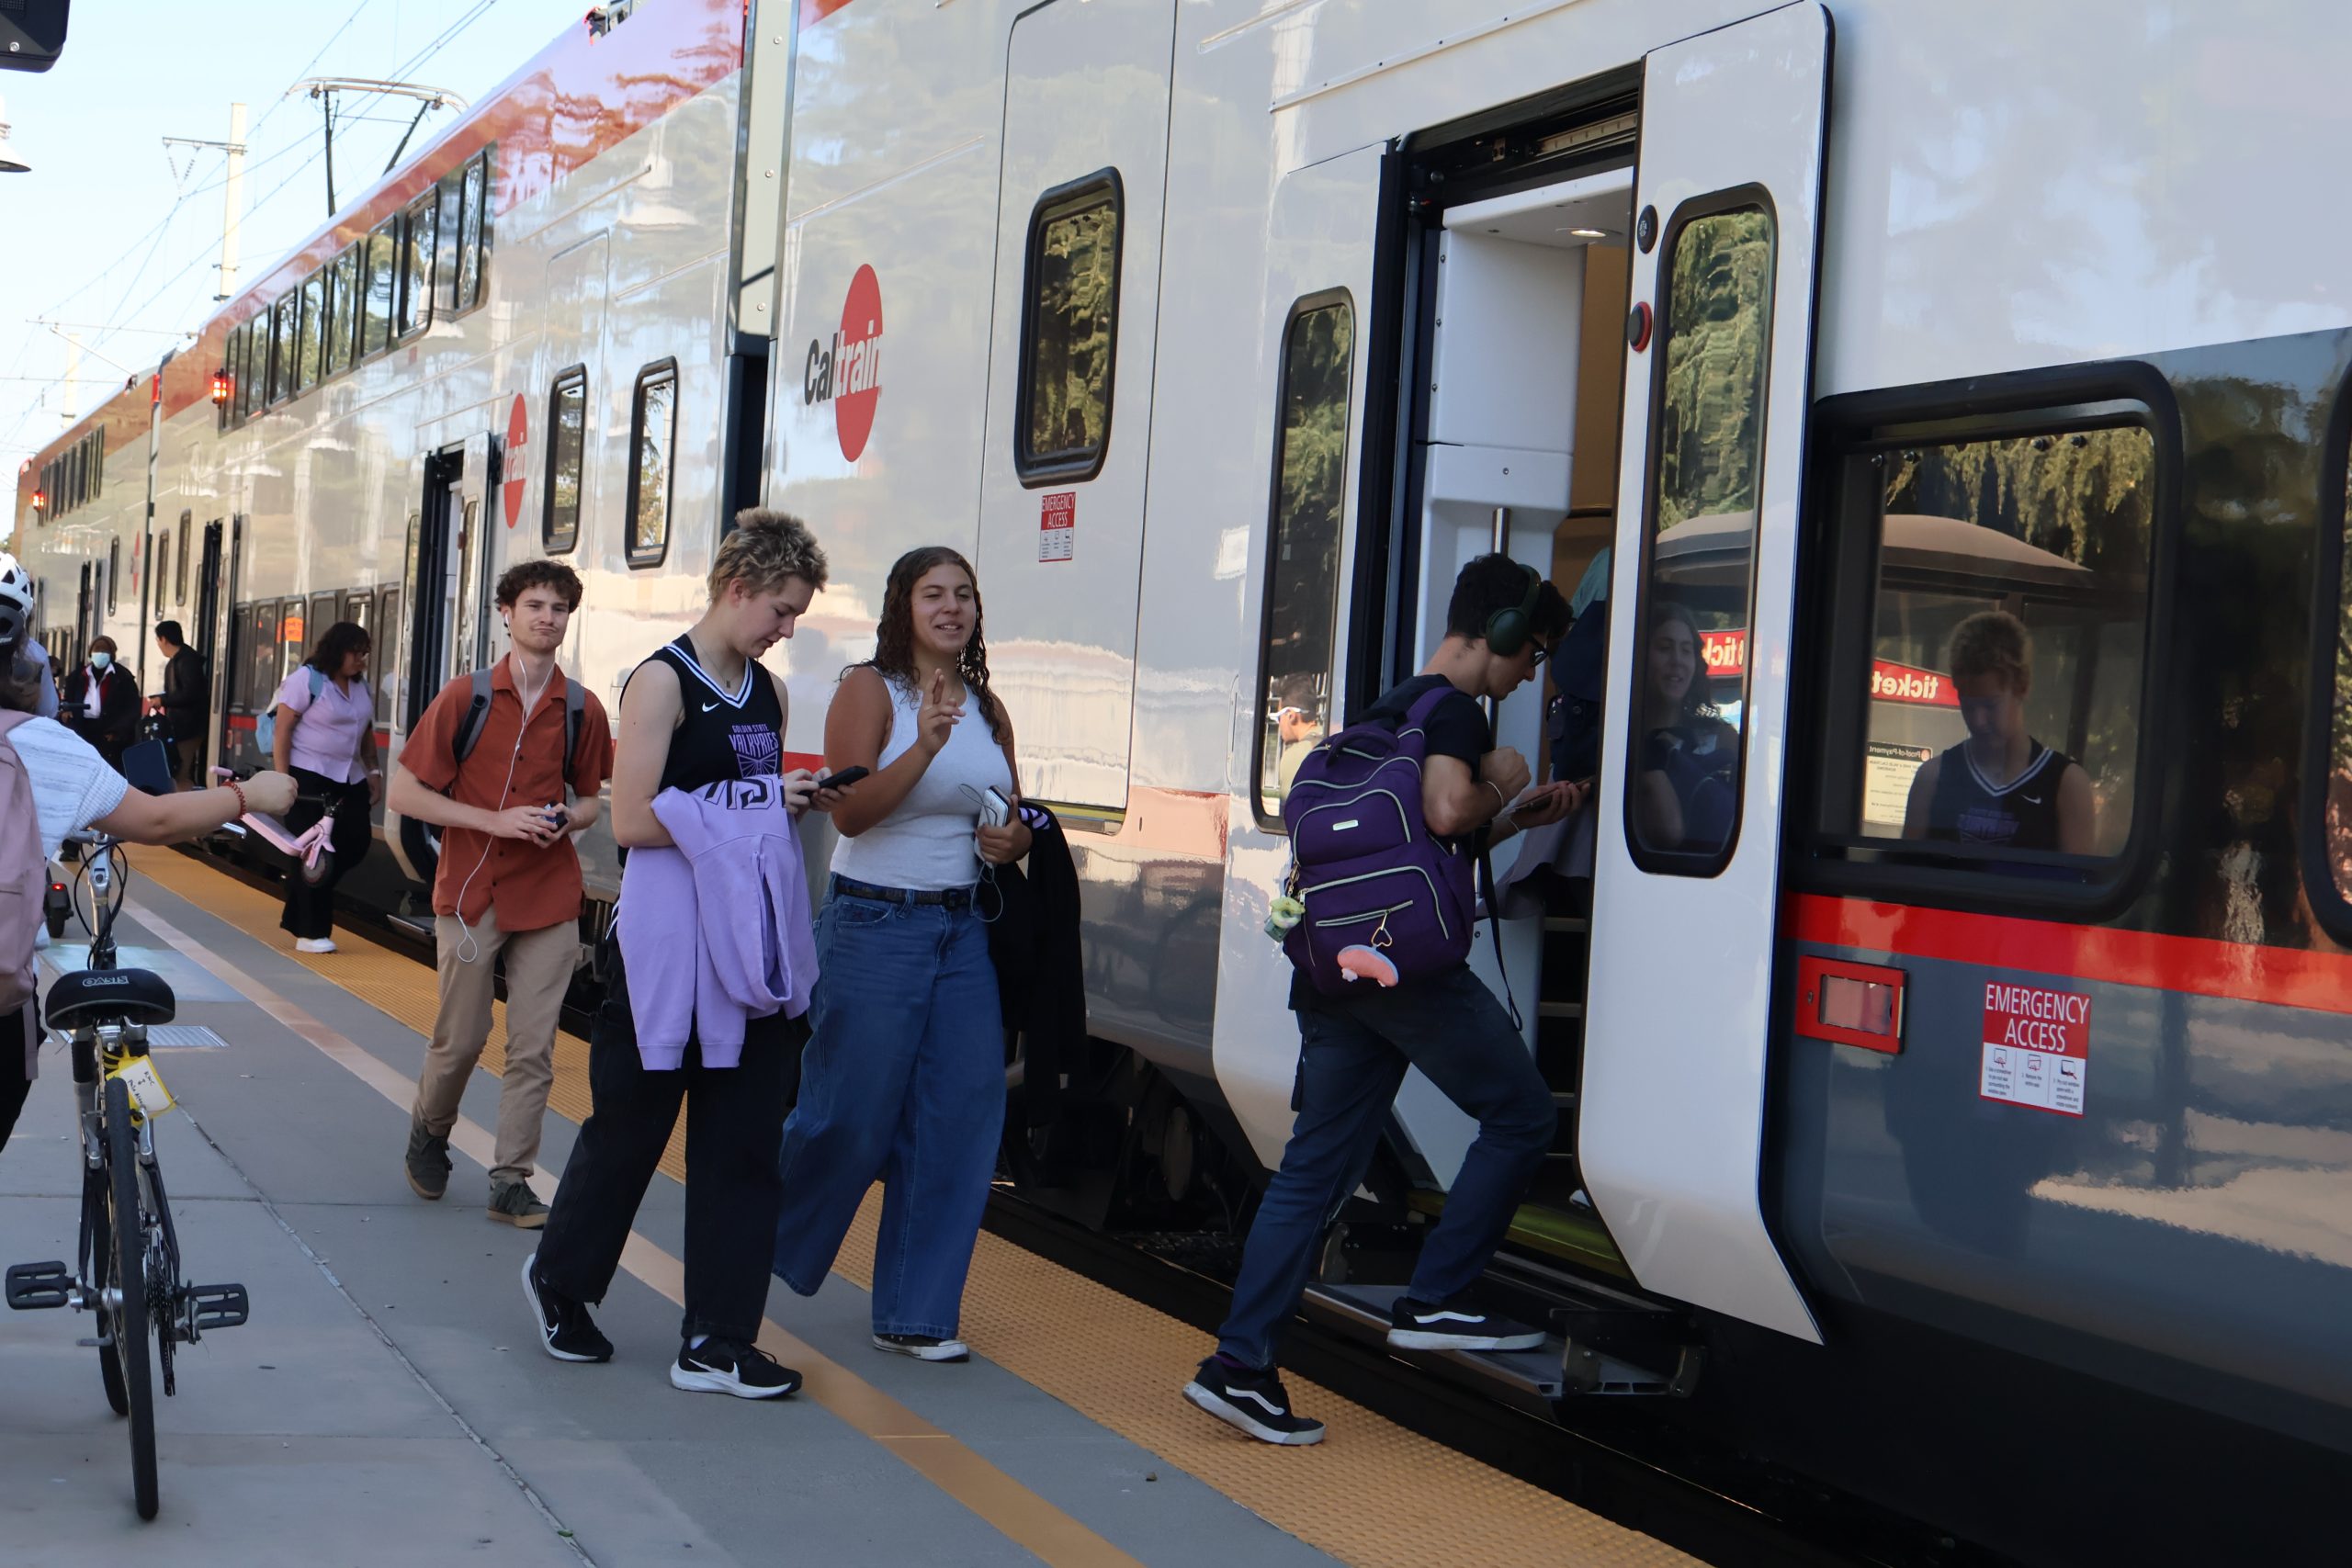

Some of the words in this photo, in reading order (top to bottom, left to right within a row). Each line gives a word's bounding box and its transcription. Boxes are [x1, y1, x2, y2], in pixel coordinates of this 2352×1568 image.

[804, 320, 883, 406] Caltrain
[1042, 493, 1075, 512] EMERGENCY
[1047, 512, 1068, 528] ACCESS
[732, 724, 752, 733] GOLDEN
[753, 723, 769, 733] STATE
[729, 732, 779, 758] VALKYRIES
[82, 976, 130, 987] OASIS
[1985, 984, 2090, 1024] EMERGENCY
[2004, 1018, 2066, 1053] ACCESS
